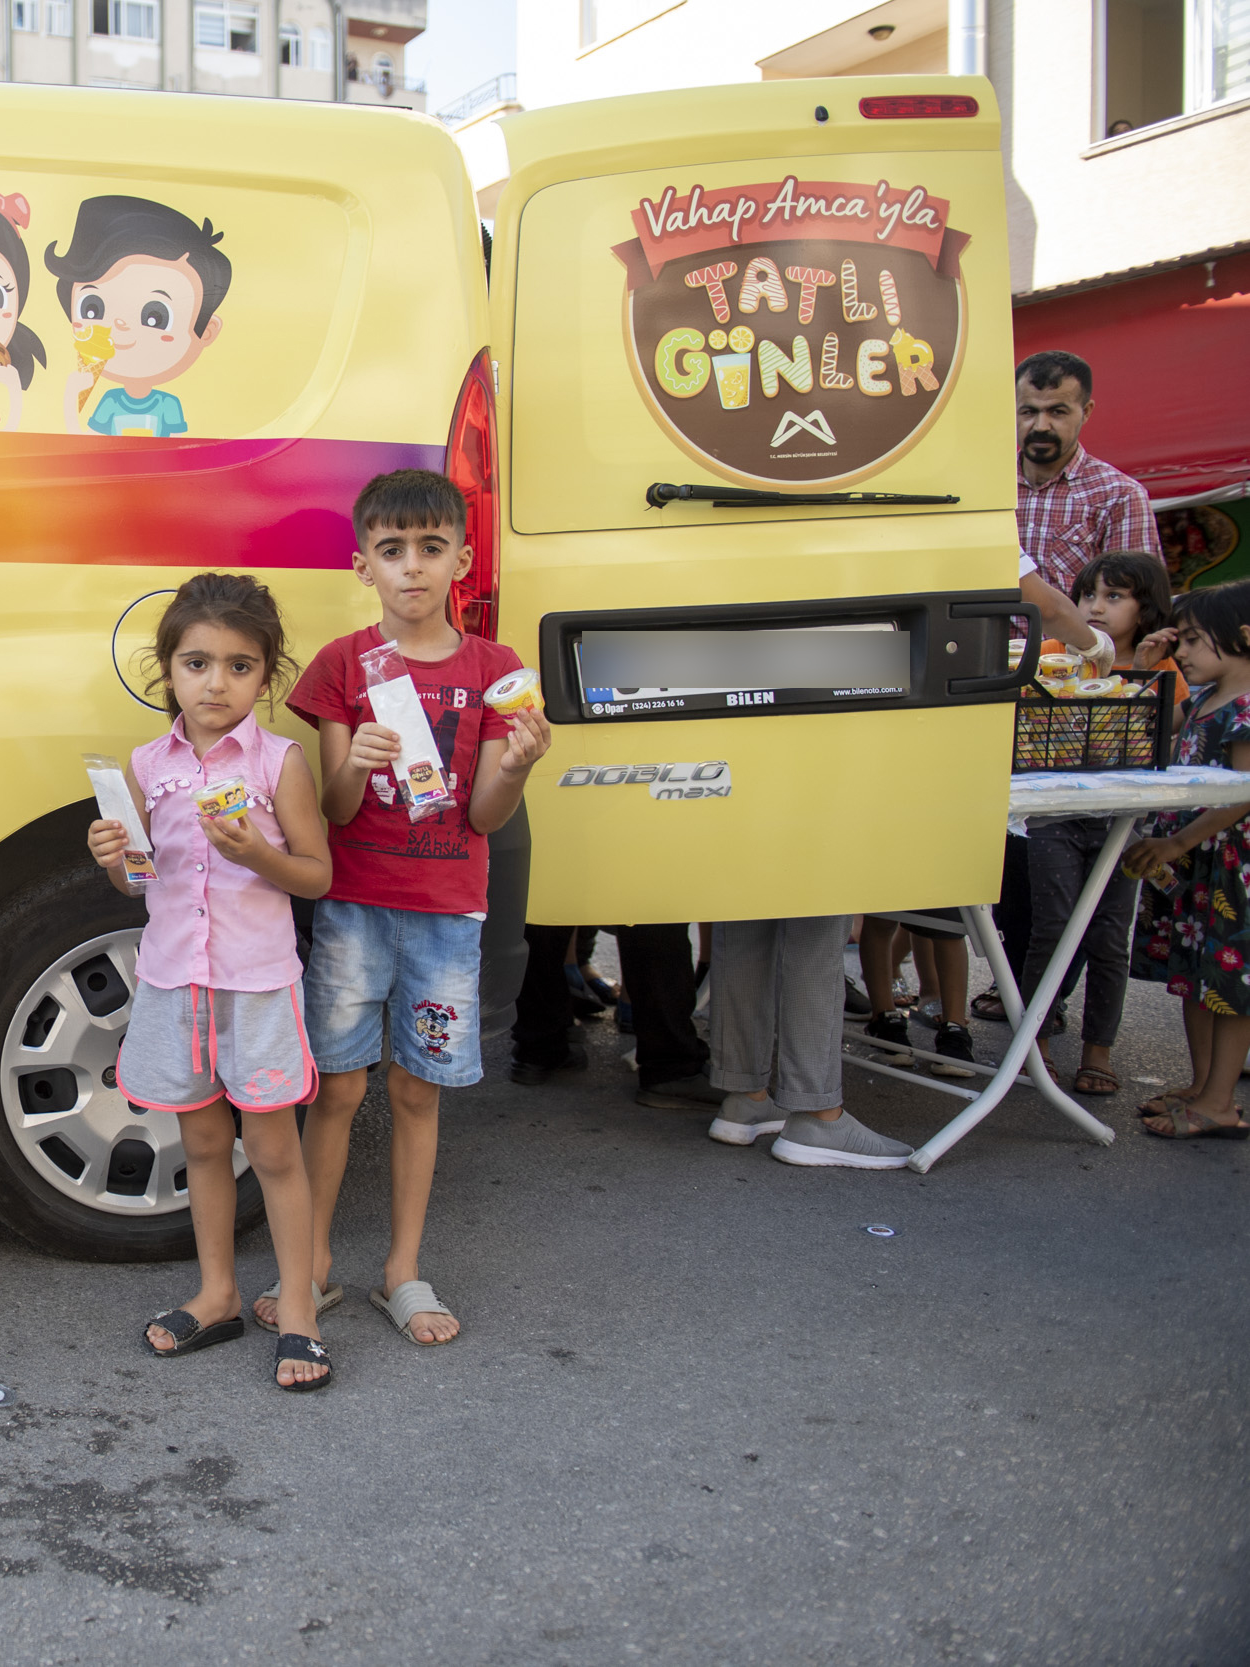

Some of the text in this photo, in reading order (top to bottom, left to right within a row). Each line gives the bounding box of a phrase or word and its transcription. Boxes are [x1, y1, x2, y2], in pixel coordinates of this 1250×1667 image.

[643, 187, 756, 242] Vahap
[684, 256, 902, 326] TATLI
[654, 325, 940, 410] GÜNLER
[631, 701, 652, 711] (324)
[652, 700, 666, 709] 226
[667, 700, 676, 708] 16
[676, 699, 685, 707] 16
